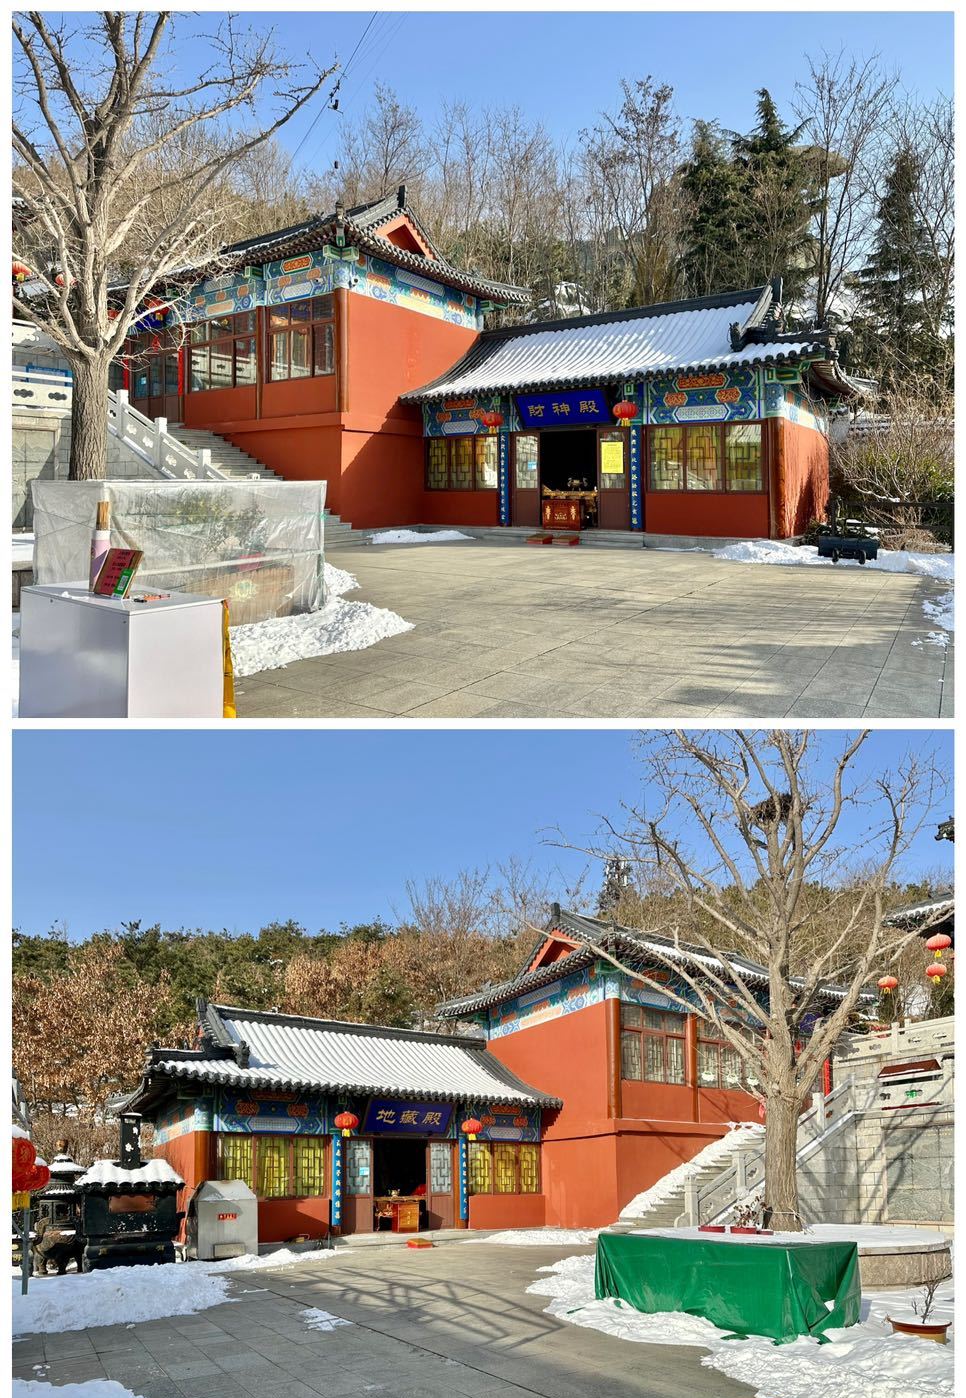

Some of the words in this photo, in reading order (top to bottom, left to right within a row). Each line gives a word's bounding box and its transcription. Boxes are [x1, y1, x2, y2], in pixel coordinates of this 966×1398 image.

[528, 400, 599, 417] 財神殿
[376, 1109, 442, 1126] 地藏殿
